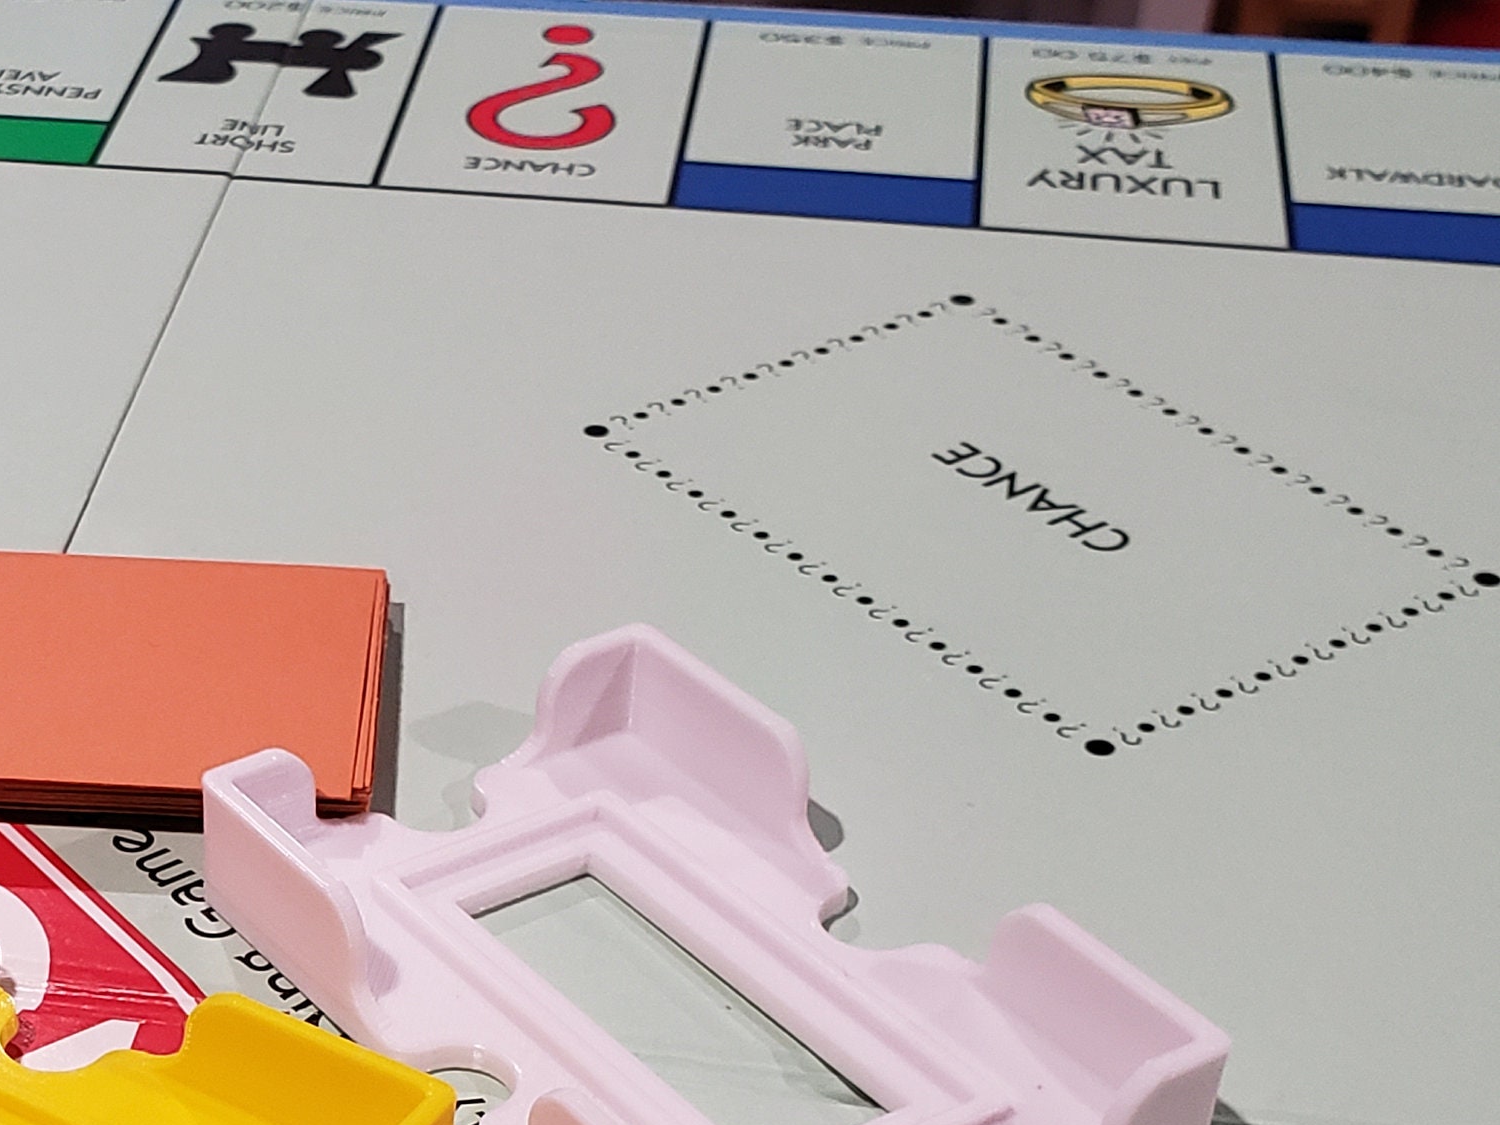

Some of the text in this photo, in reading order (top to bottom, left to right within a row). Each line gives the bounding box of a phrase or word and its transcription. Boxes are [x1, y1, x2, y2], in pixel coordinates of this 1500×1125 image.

[223, 117, 287, 138] LINE
[785, 117, 884, 137] PLACE
[193, 130, 296, 155] SHORT
[791, 133, 873, 152] PARK
[463, 155, 597, 178] CHANCE
[1075, 144, 1173, 171] TAX
[1026, 167, 1223, 200] LUXURY
[931, 441, 1130, 552] CHANCE
[112, 828, 237, 939] Game
